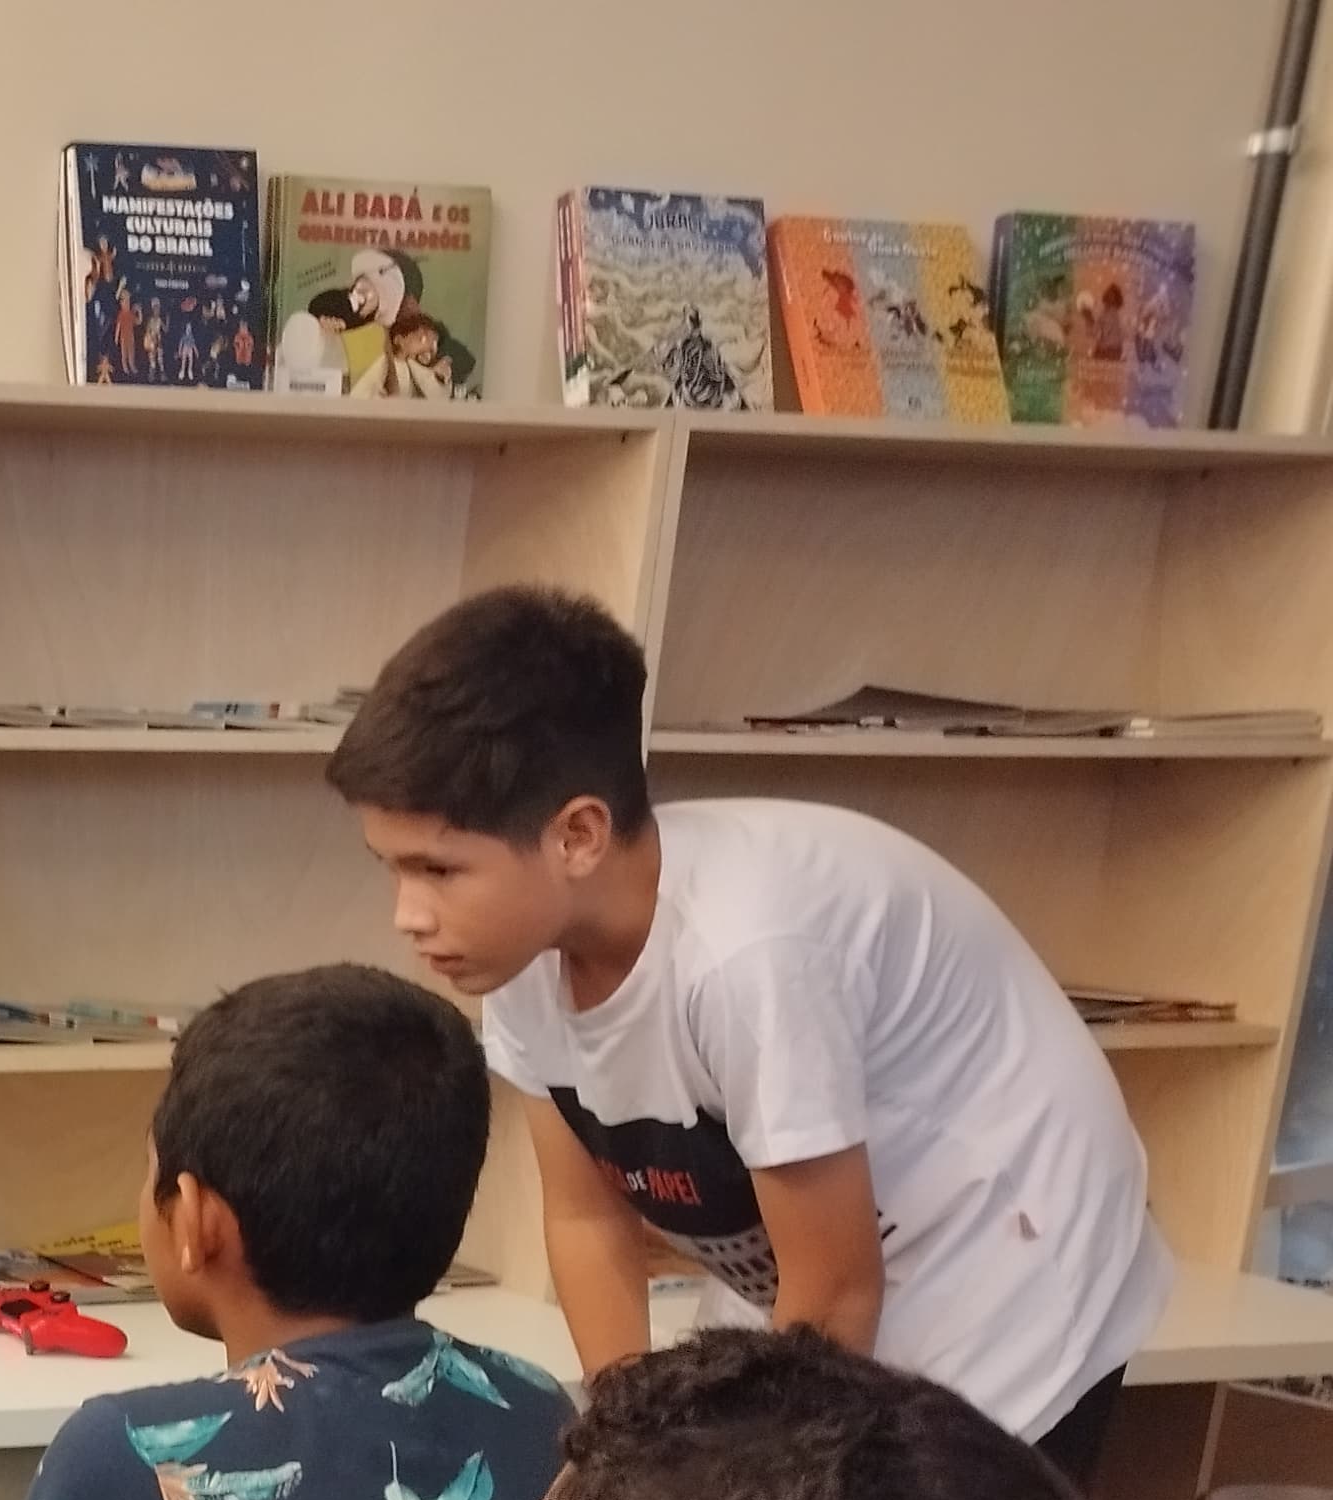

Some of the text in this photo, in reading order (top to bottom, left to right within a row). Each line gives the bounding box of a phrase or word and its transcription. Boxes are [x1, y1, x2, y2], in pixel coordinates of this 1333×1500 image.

[102, 194, 234, 220] MANIFESTAÇÕES
[300, 189, 345, 217] ALI
[353, 185, 423, 221] BABÁ
[447, 204, 471, 225] OS
[126, 215, 213, 238] CULTURAIS
[297, 223, 472, 250] QUARENTA LADRÕES
[127, 234, 213, 257] DO BRASIL
[626, 1169, 648, 1192] DE
[646, 1166, 703, 1206] PAPEL
